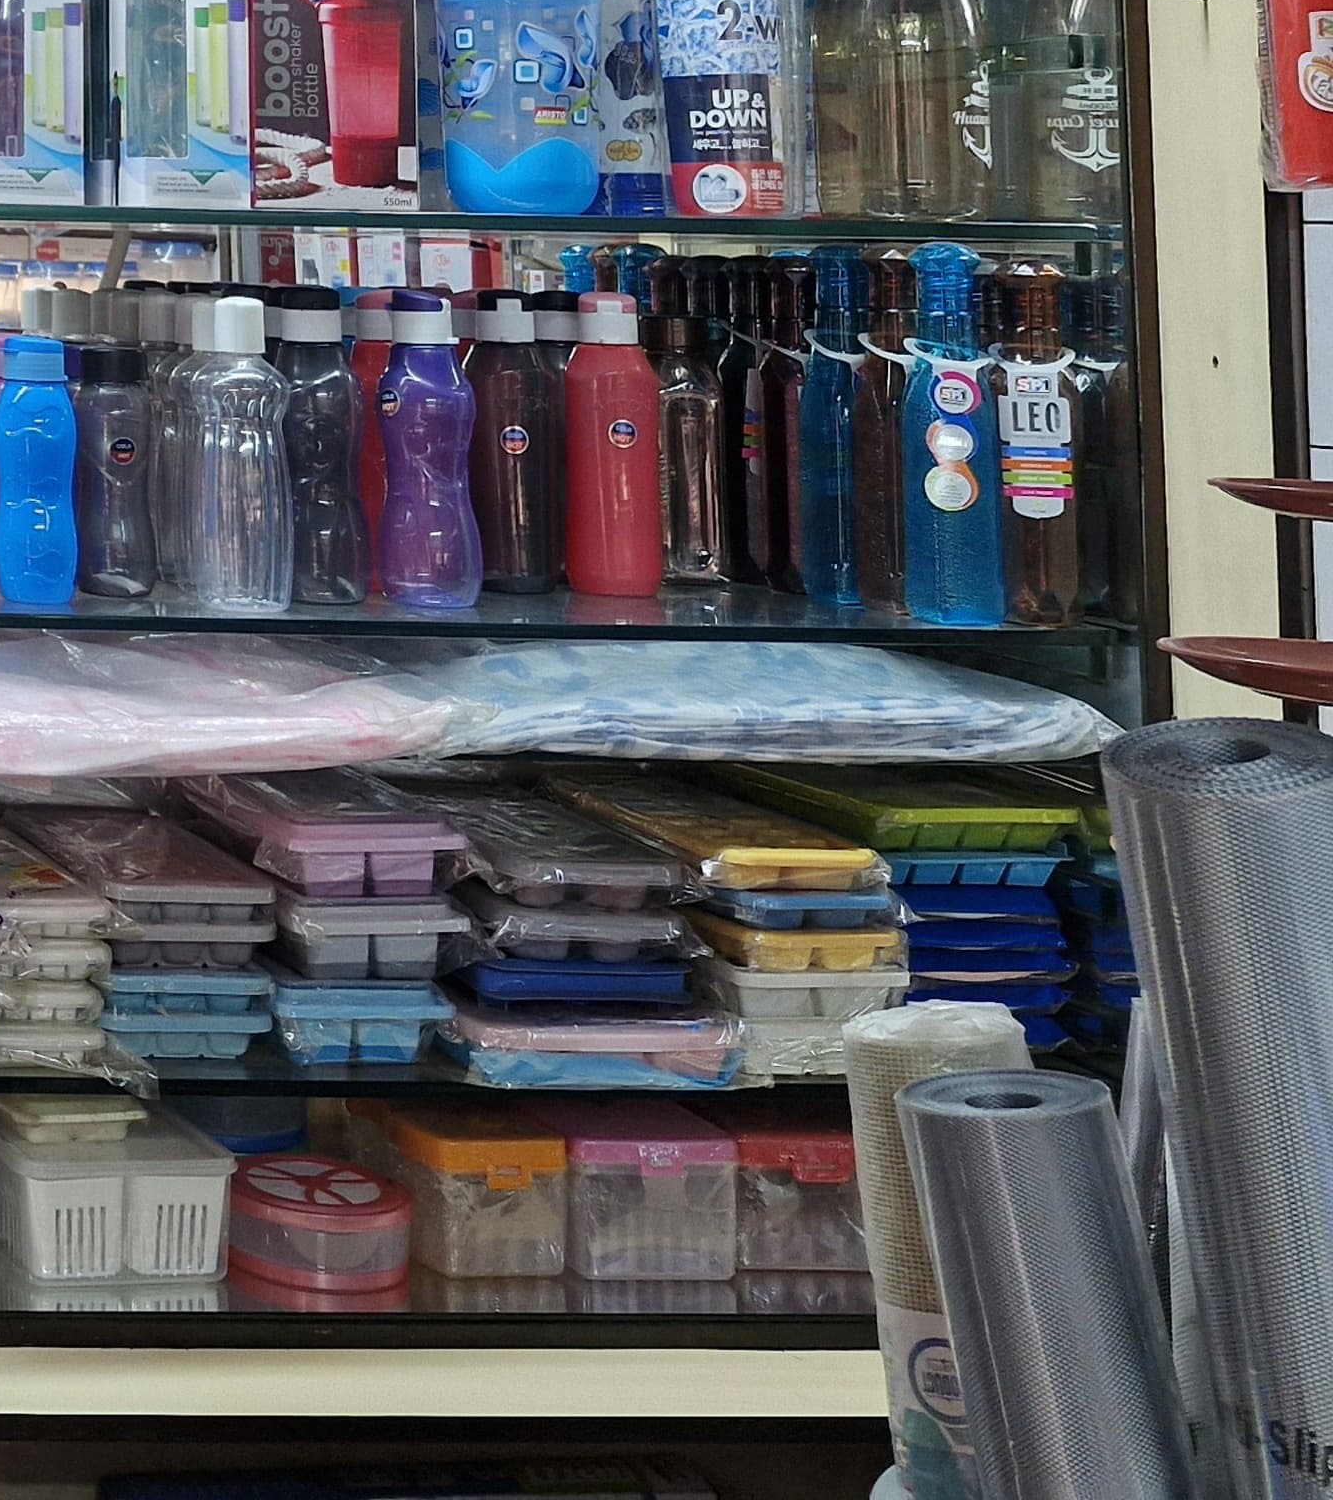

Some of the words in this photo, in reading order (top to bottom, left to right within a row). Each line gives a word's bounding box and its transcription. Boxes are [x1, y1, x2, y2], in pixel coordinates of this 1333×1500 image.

[289, 22, 302, 81] shaker
[291, 85, 306, 118] gym
[305, 62, 319, 118] bottle
[711, 88, 749, 110] UP
[751, 92, 766, 109] &
[689, 109, 767, 128] DOWN
[382, 196, 413, 208] 550ml
[1011, 401, 1061, 433] LEO
